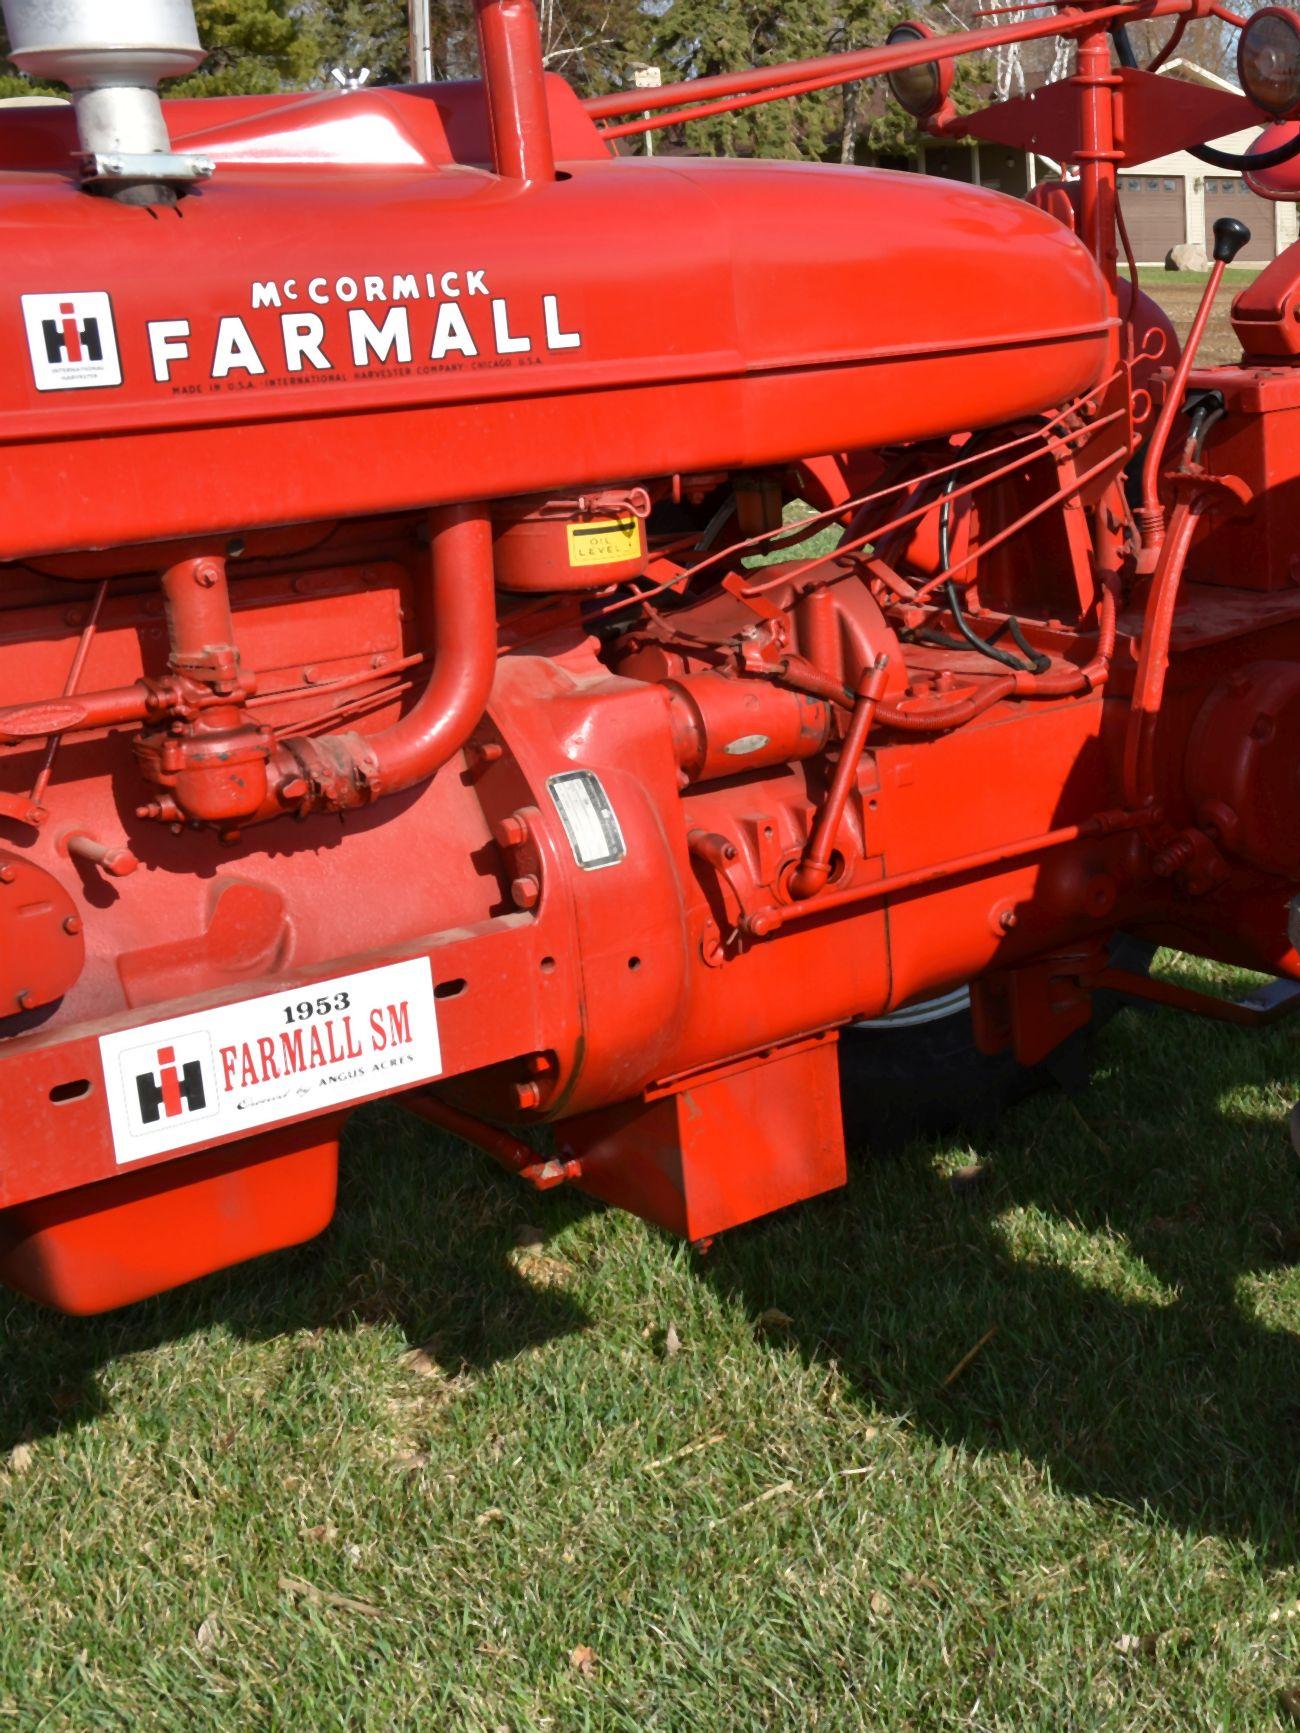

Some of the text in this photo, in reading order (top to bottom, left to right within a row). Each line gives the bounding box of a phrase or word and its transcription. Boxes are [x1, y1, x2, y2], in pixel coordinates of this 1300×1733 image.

[146, 294, 582, 383] FARMALL
[172, 385, 203, 395] MADE
[209, 383, 222, 392] IN
[264, 374, 348, 388] INTERNATIONAL
[354, 366, 412, 380] HARVESTER
[416, 363, 464, 376] COMPANY
[471, 358, 512, 371] CHICAGO
[578, 544, 621, 557] LEVEL
[590, 537, 609, 545] OIL
[282, 991, 352, 1025] 1953
[219, 1000, 413, 1092] FARMALL SM
[318, 1067, 365, 1087] ANGUS
[371, 1054, 415, 1073] ACRES
